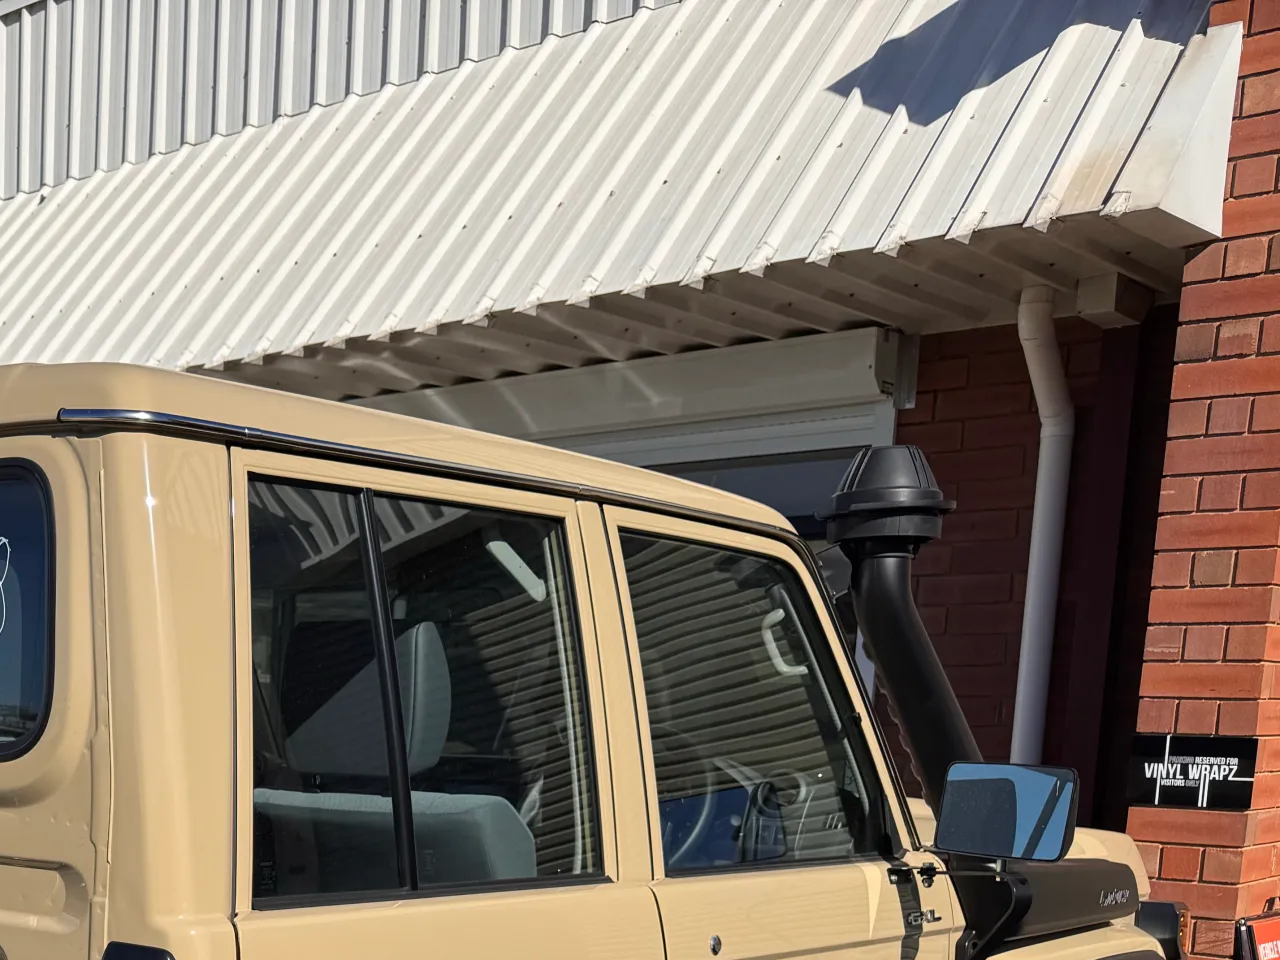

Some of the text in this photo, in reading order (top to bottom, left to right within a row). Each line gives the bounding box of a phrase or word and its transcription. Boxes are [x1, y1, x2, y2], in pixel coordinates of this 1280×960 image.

[1195, 757, 1225, 765] RESERVED
[1226, 757, 1239, 765] FOR
[1144, 762, 1240, 781] VINYL WRAPZ
[1161, 779, 1185, 787] VISITORS
[907, 908, 942, 926] GXL
